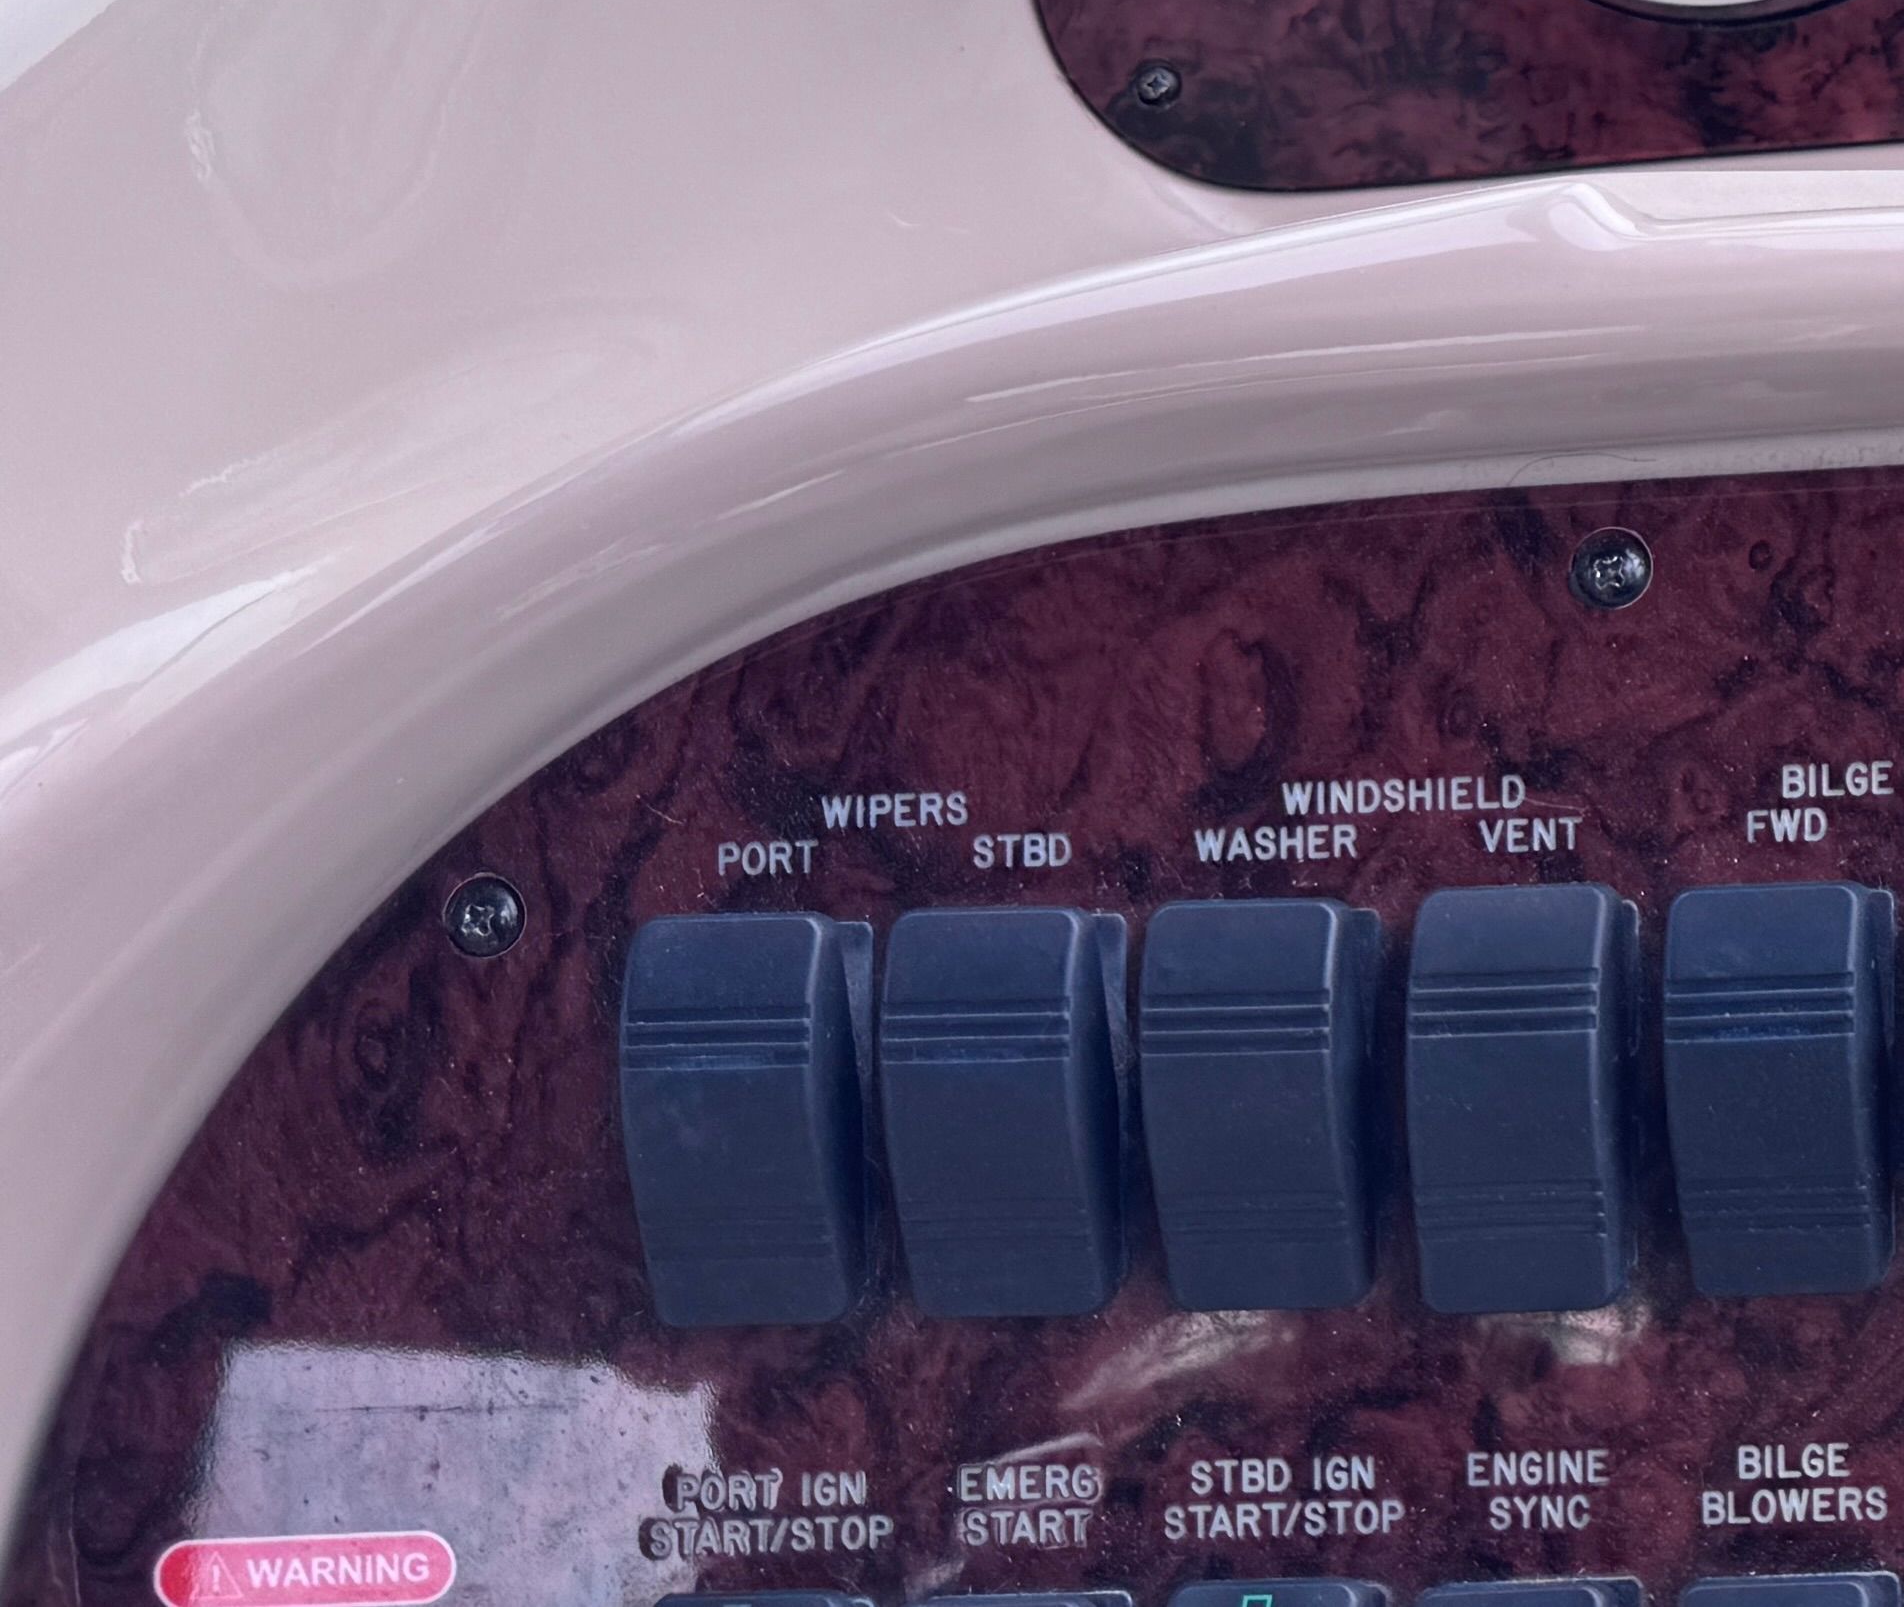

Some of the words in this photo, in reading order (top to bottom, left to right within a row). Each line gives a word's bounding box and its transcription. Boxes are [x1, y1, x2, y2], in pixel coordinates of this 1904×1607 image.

[1281, 775, 1527, 817] WINDSHIELD
[1782, 760, 1895, 799] BILGE
[822, 792, 969, 829] WIPERS
[1747, 807, 1828, 844] FWD
[973, 833, 1072, 869] STBD
[1195, 825, 1358, 863] WASHER
[1479, 817, 1583, 853] VENT
[717, 840, 818, 875] PORT
[1189, 1458, 1292, 1496] STBD
[1313, 1456, 1378, 1493] IGN
[1466, 1449, 1610, 1488] ENGINE
[1736, 1443, 1851, 1481] BILGE
[674, 1472, 778, 1512] PORT
[803, 1470, 868, 1509] IGN
[957, 1464, 1099, 1504] EMERG
[1164, 1500, 1406, 1543] START/STOP
[1489, 1494, 1591, 1531] SYNC
[1701, 1485, 1889, 1526] BLOWERS
[648, 1515, 894, 1557] START/STOP
[960, 1507, 1092, 1548] START
[247, 1553, 431, 1589] WARNING
